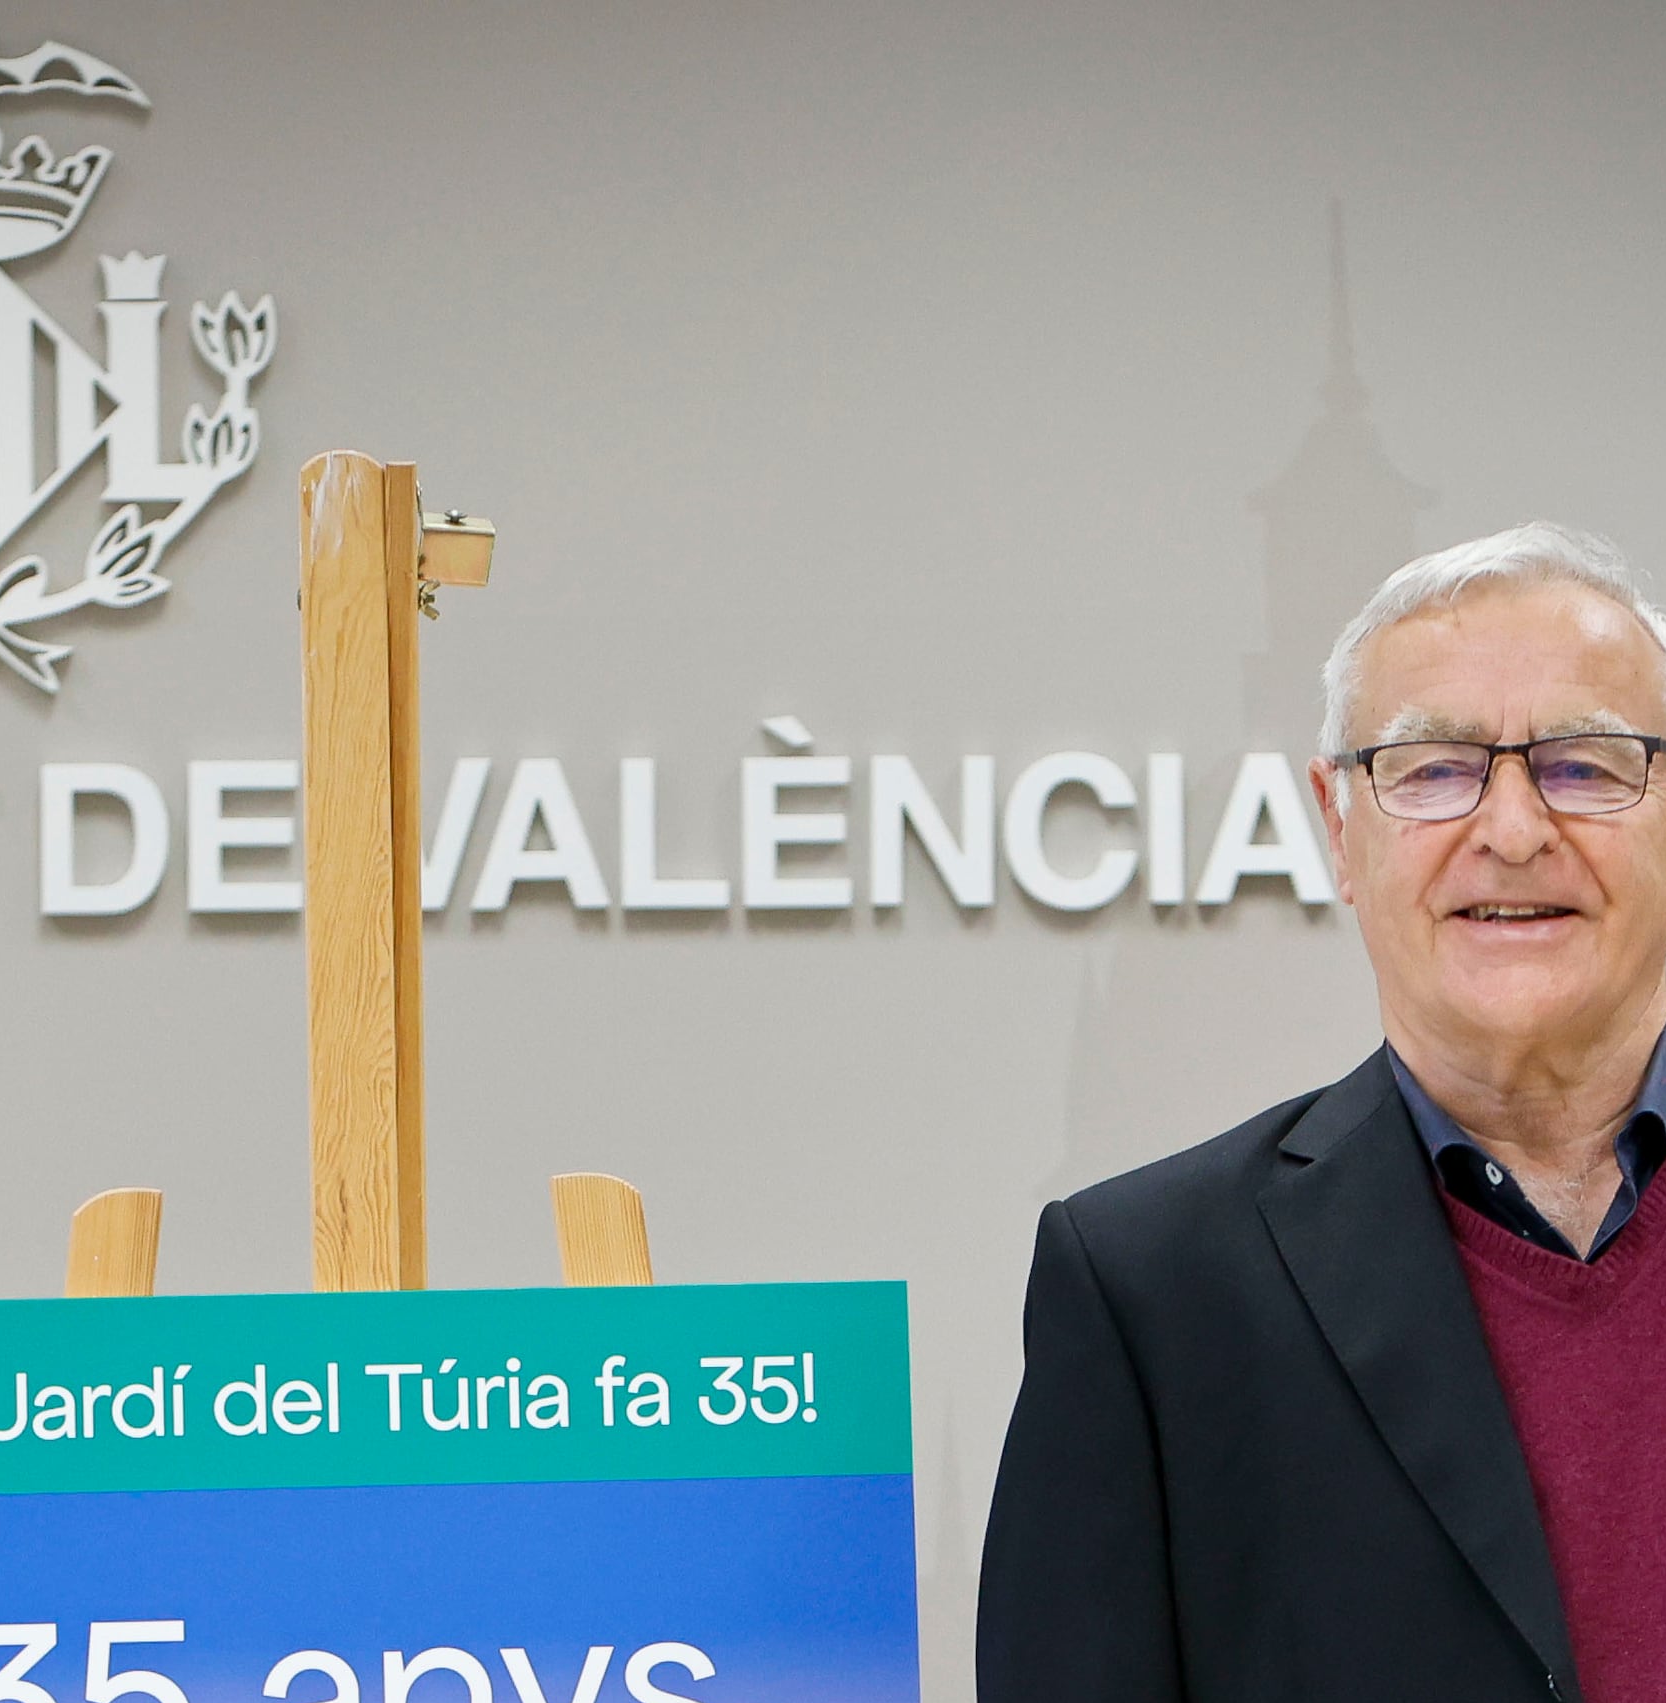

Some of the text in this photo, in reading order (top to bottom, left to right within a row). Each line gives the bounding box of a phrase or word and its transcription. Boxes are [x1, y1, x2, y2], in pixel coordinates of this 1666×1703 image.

[40, 759, 304, 914] DE
[213, 1362, 339, 1436] del
[364, 1357, 570, 1431] Túria
[594, 1355, 670, 1427] fa
[698, 1352, 817, 1425] 35!
